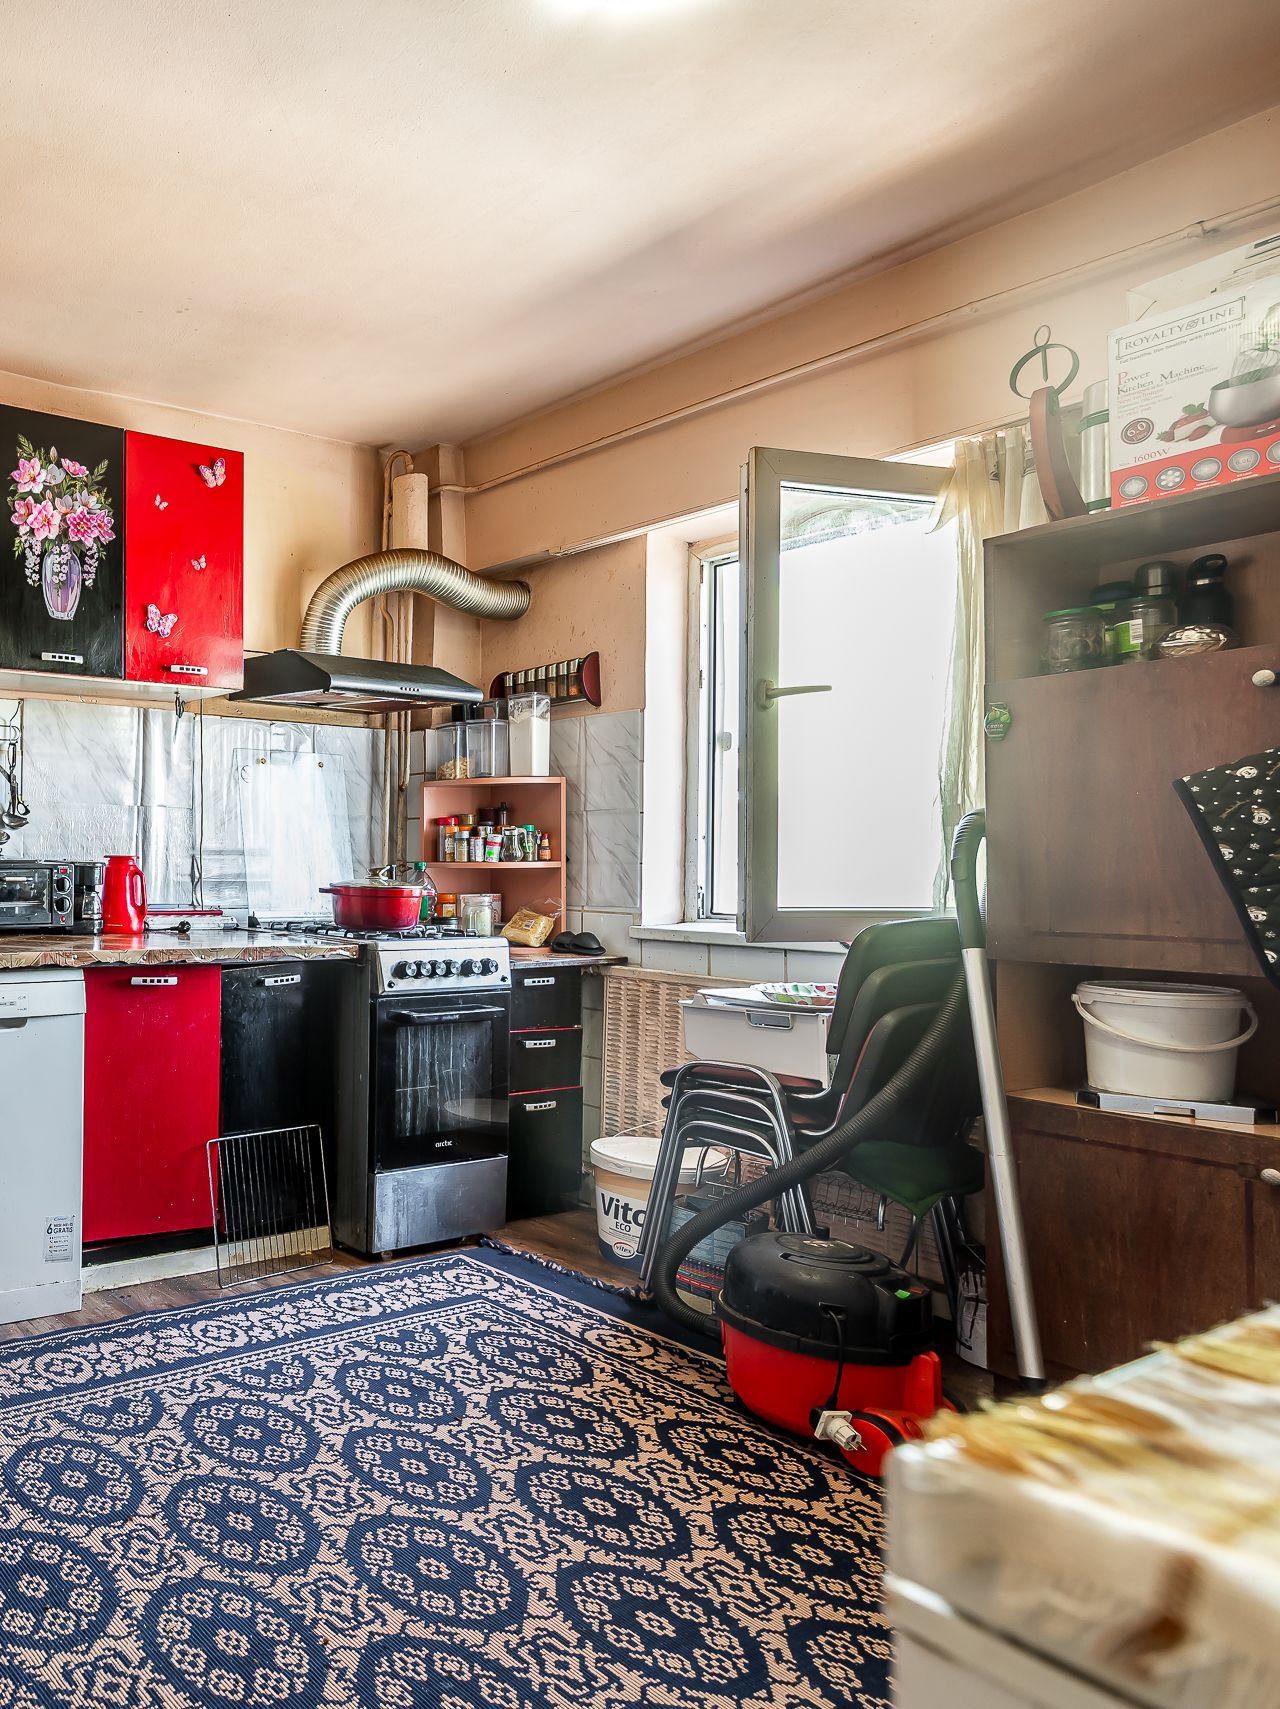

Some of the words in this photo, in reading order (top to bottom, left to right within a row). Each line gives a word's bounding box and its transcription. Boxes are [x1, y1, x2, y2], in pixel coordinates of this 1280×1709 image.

[1125, 324, 1187, 350] ROYALTY
[1201, 306, 1236, 325] LINE
[1117, 371, 1151, 386] Power
[1117, 380, 1154, 395] Kitchen
[1159, 364, 1206, 382] Machine
[1127, 422, 1146, 437] 6.0
[1134, 448, 1170, 464] 1600W
[435, 1140, 453, 1148] arctic
[46, 1223, 53, 1235] 6
[615, 1221, 631, 1233] ECO
[615, 1245, 632, 1255] vitex
